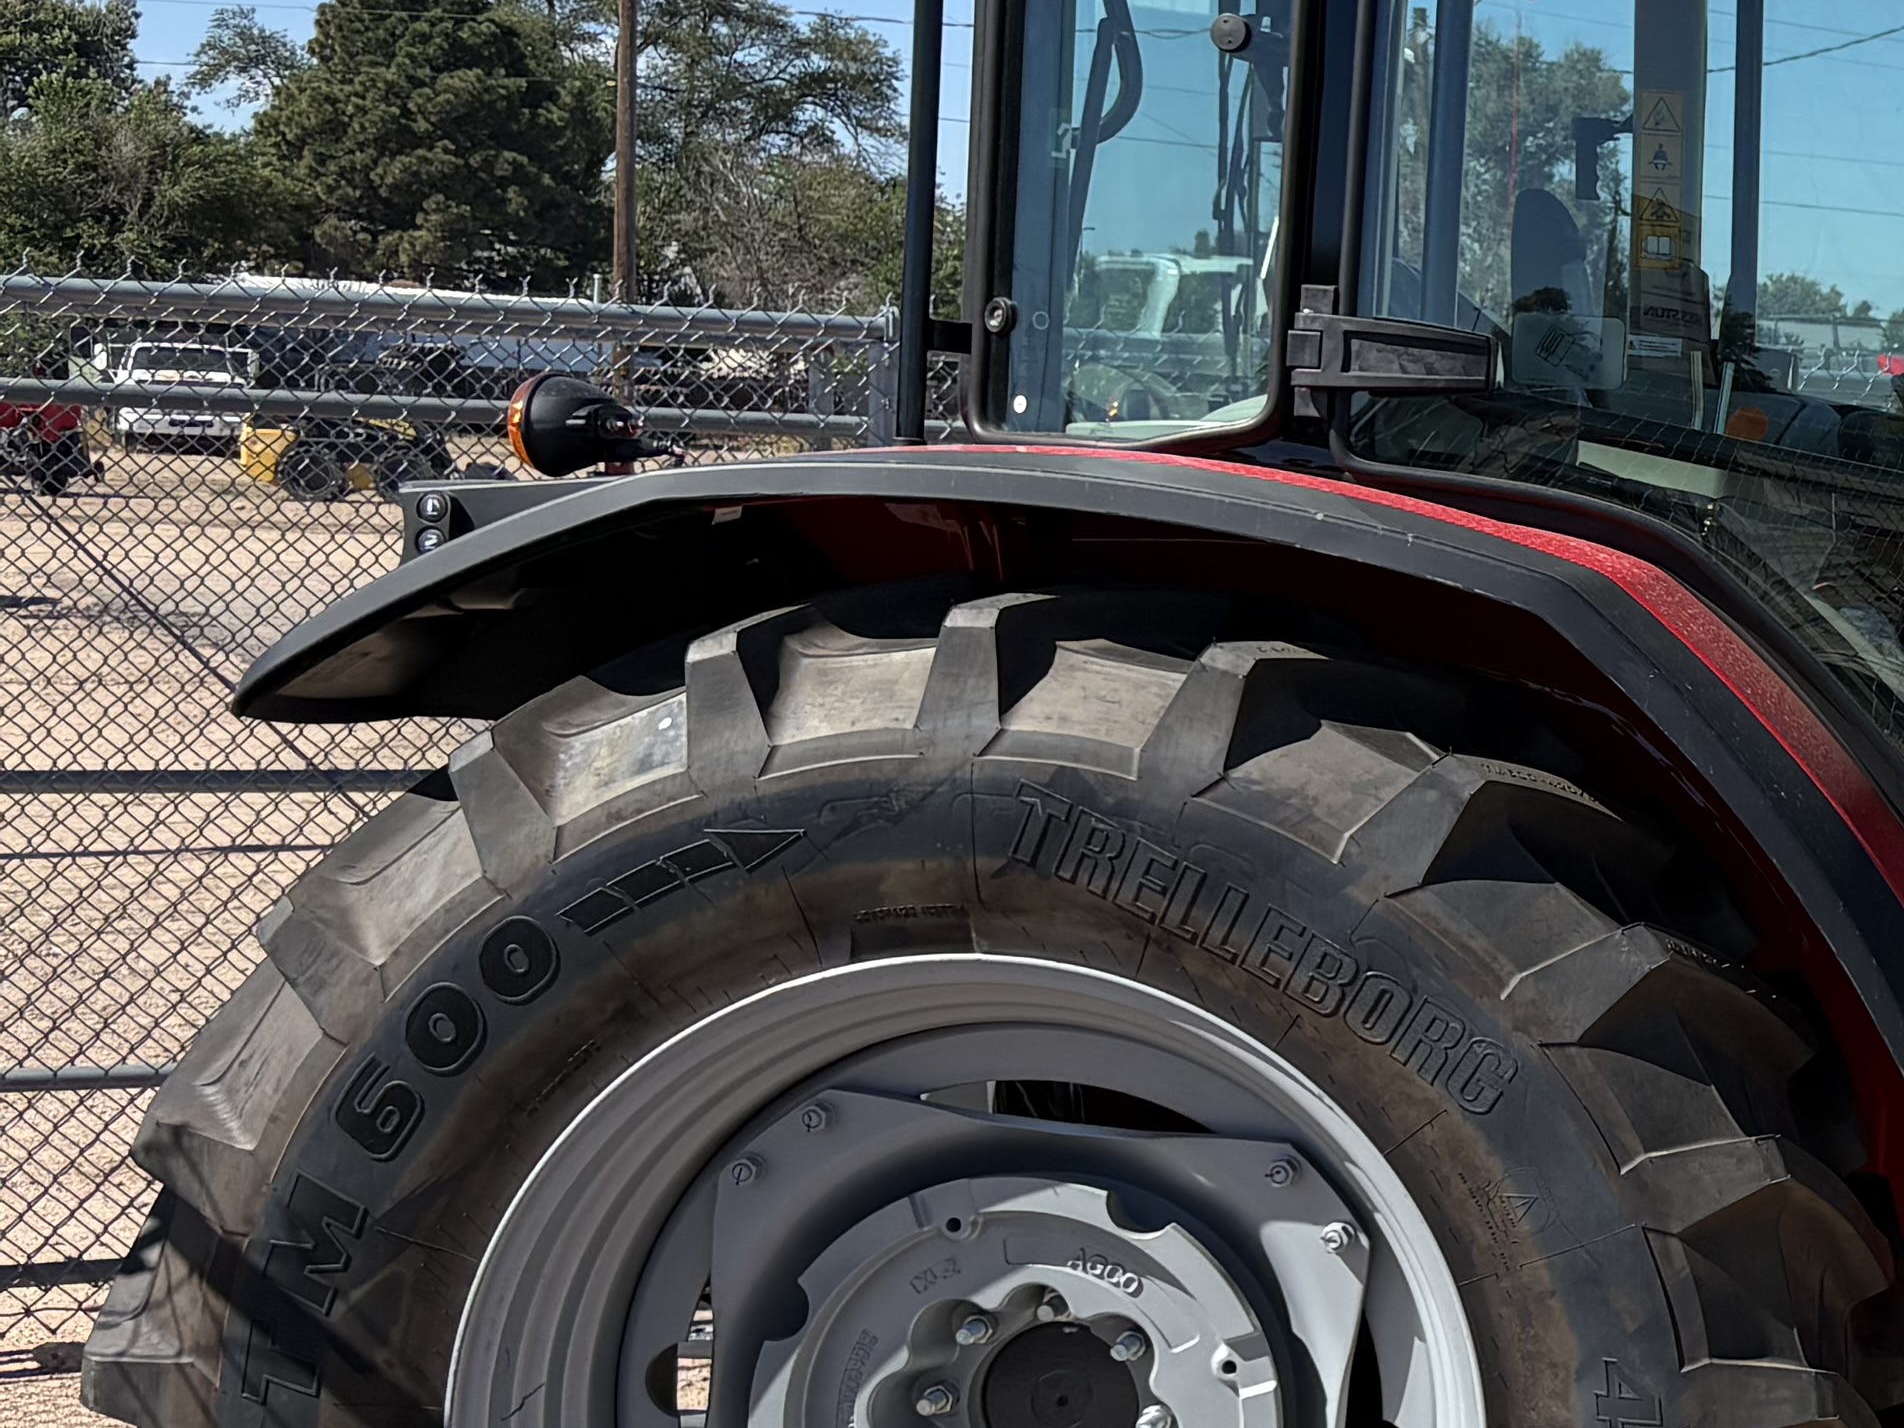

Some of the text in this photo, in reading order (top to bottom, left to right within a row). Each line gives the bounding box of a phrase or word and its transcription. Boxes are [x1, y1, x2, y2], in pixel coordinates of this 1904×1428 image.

[1003, 780, 1524, 1118] TRELLEBORG
[240, 1172, 372, 1405] TM
[333, 915, 563, 1163] 600
[1066, 1247, 1145, 1298] AGCO
